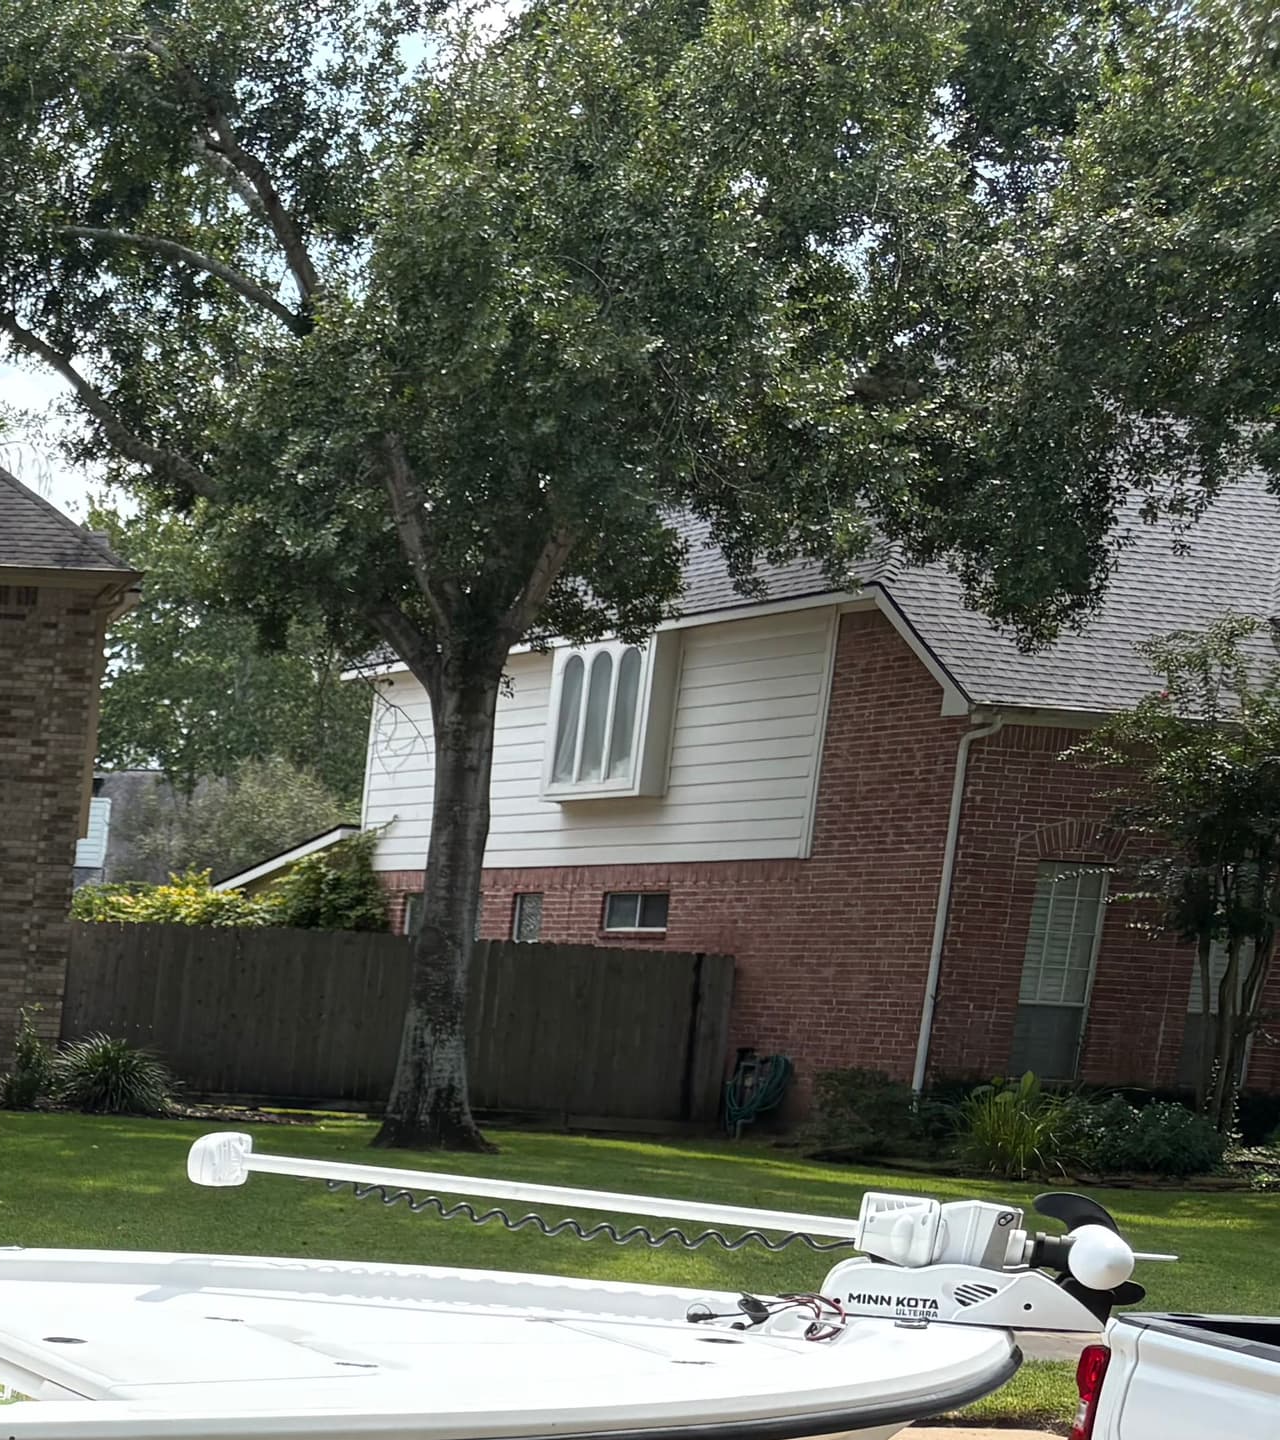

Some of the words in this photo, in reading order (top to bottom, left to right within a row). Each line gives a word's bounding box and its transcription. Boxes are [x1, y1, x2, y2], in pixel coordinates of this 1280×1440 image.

[848, 1292, 892, 1306] MINN
[896, 1297, 939, 1310] KOTA
[895, 1308, 938, 1318] ULTERRA
